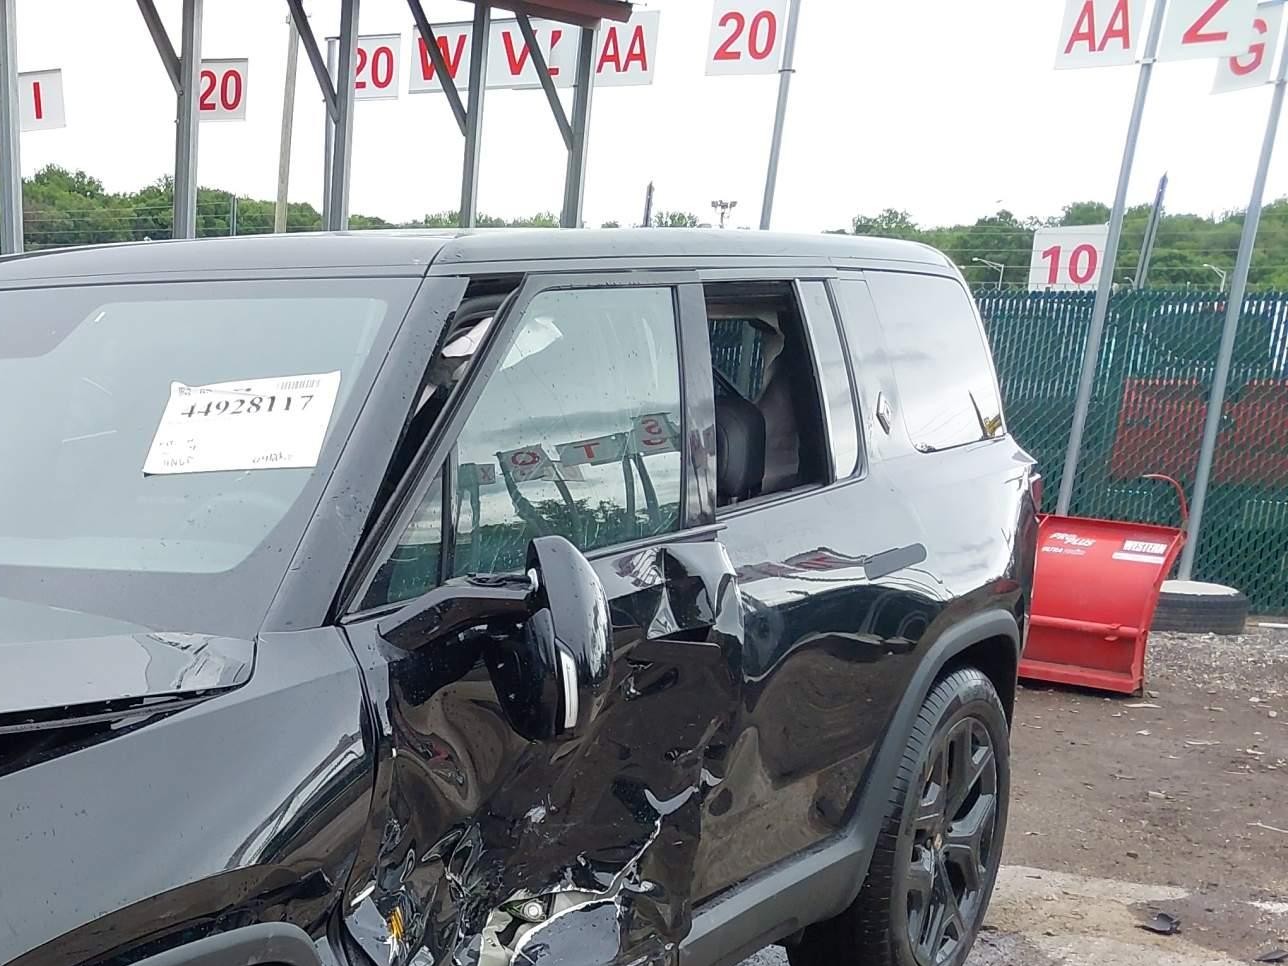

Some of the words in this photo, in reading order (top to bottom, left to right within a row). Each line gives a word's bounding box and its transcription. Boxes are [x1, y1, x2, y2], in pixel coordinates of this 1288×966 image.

[596, 25, 648, 73] AA
[713, 10, 777, 60] 20
[1064, 0, 1130, 54] AA
[355, 46, 394, 88] 20
[417, 34, 468, 81] W
[501, 29, 538, 76] V
[199, 69, 242, 111] 20
[1041, 244, 1098, 284] 10
[180, 394, 314, 418] 44928117
[1122, 540, 1168, 555] WESTERN
